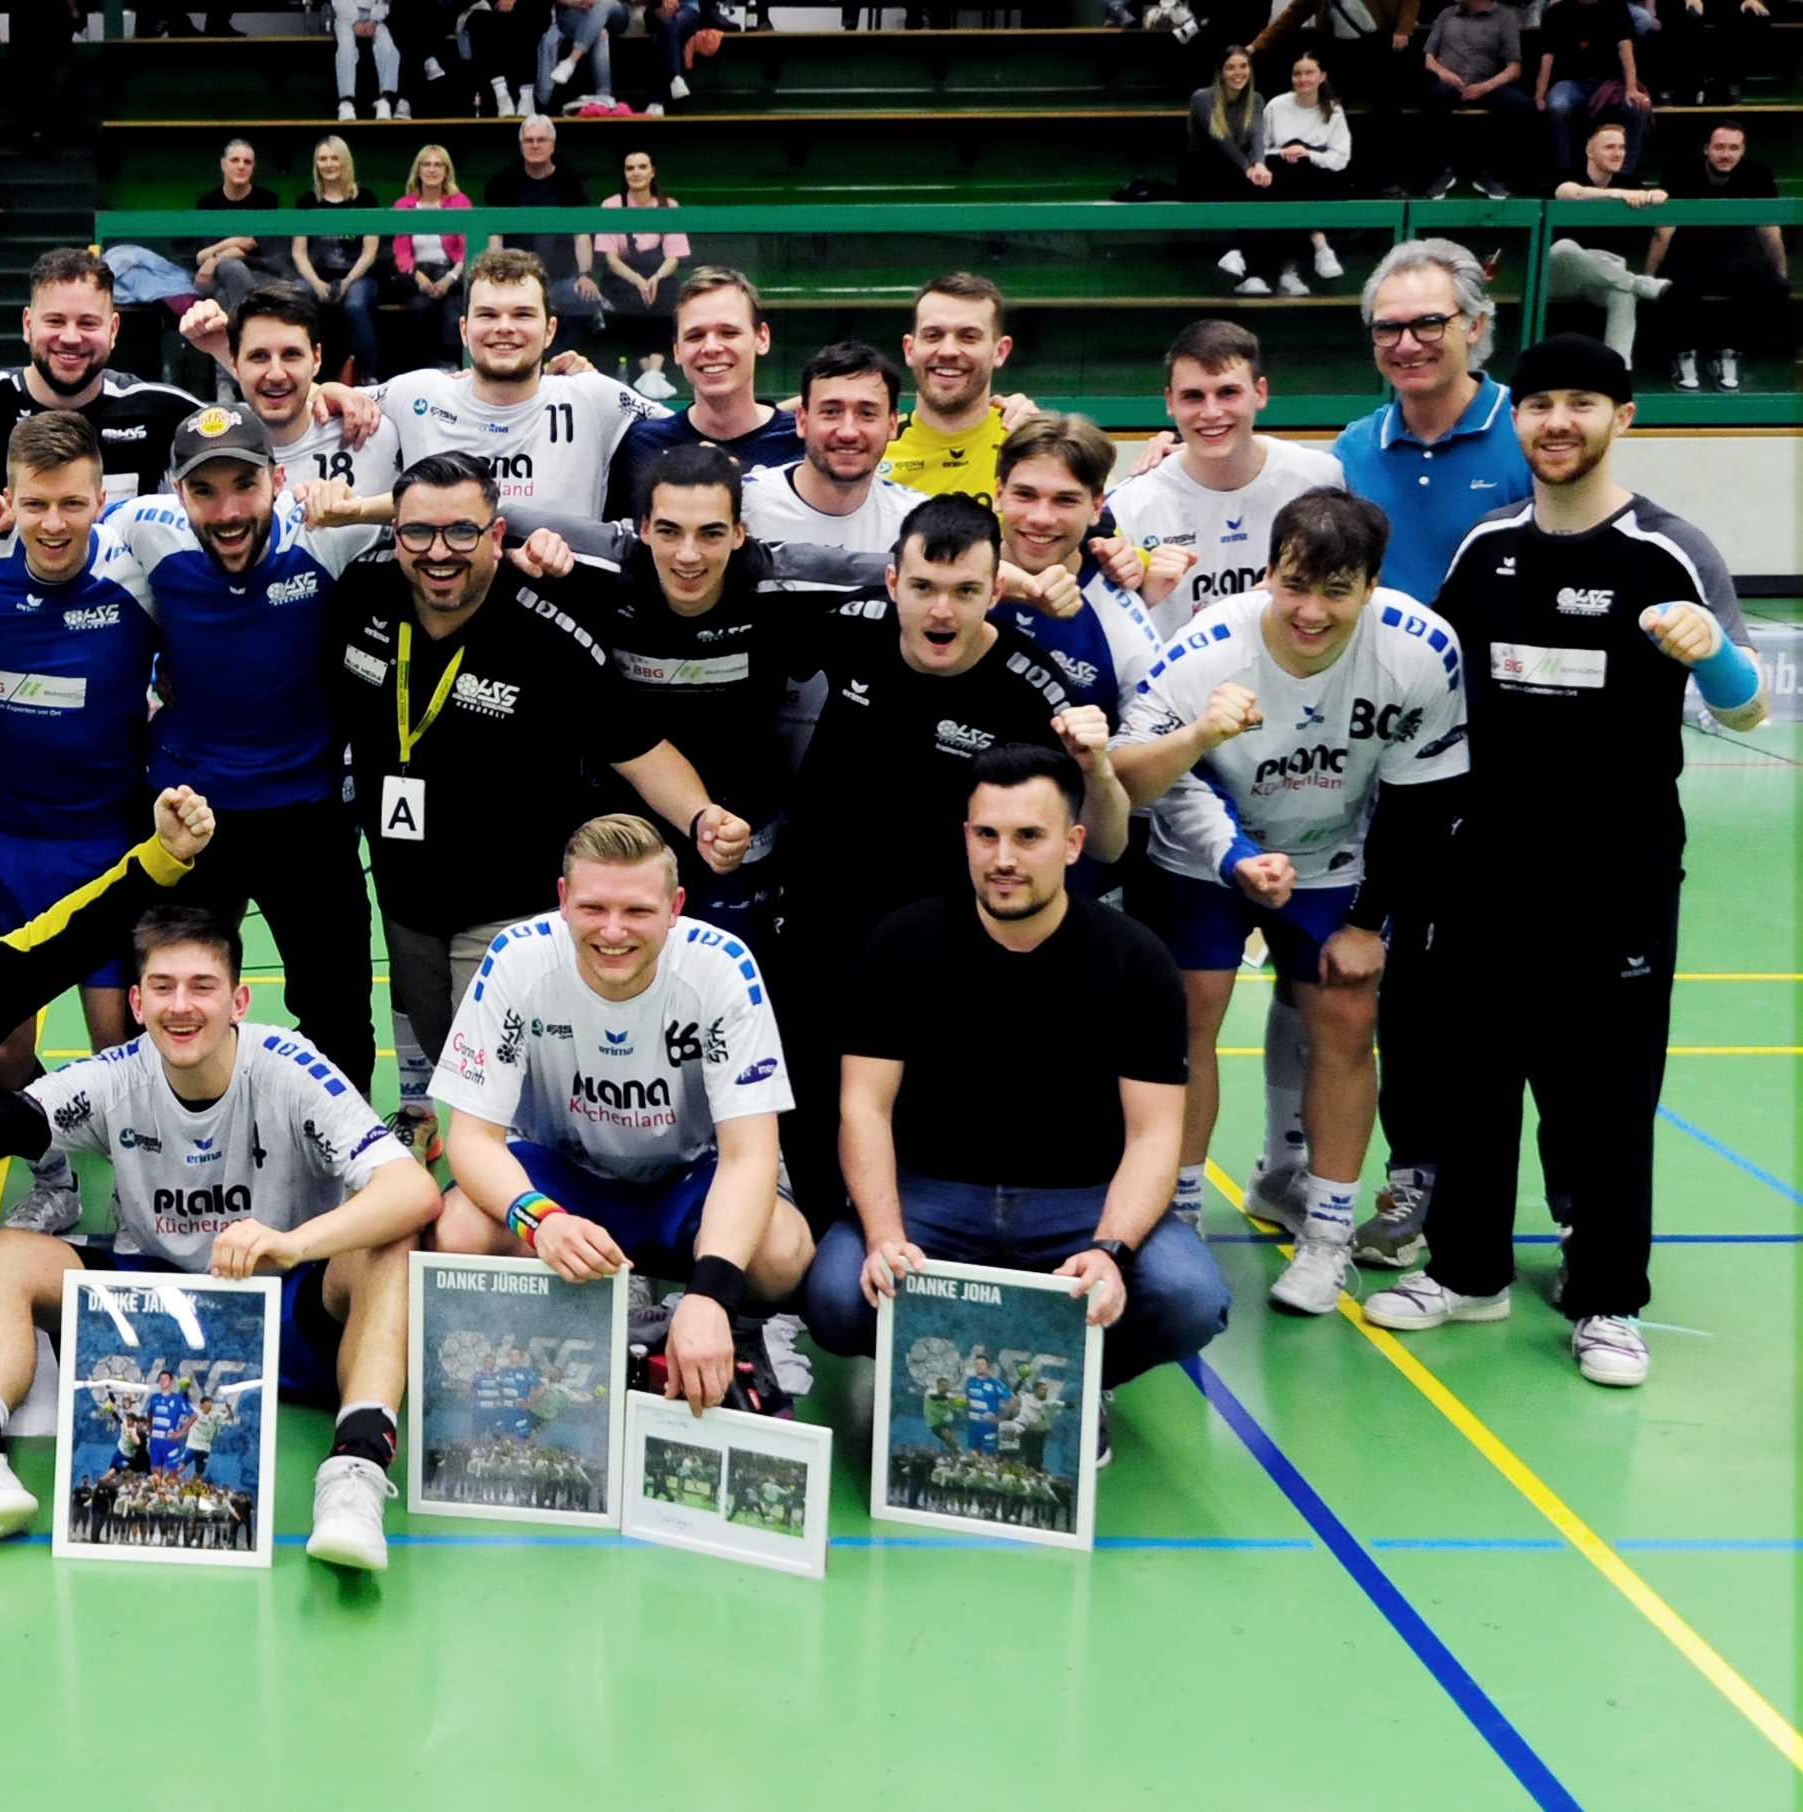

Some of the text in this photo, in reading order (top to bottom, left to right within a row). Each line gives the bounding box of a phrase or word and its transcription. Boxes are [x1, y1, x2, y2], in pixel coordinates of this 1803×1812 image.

[545, 403, 573, 443] 11
[313, 452, 354, 488] 18
[633, 665, 665, 678] BBG
[387, 797, 418, 831] A
[474, 1049, 485, 1067] &
[598, 1045, 634, 1057] erima
[459, 1058, 485, 1086] Raith
[186, 1150, 222, 1164] erima
[436, 1270, 549, 1295] DANKE JÜRGEN
[906, 1275, 1002, 1304] DANKE JOHA
